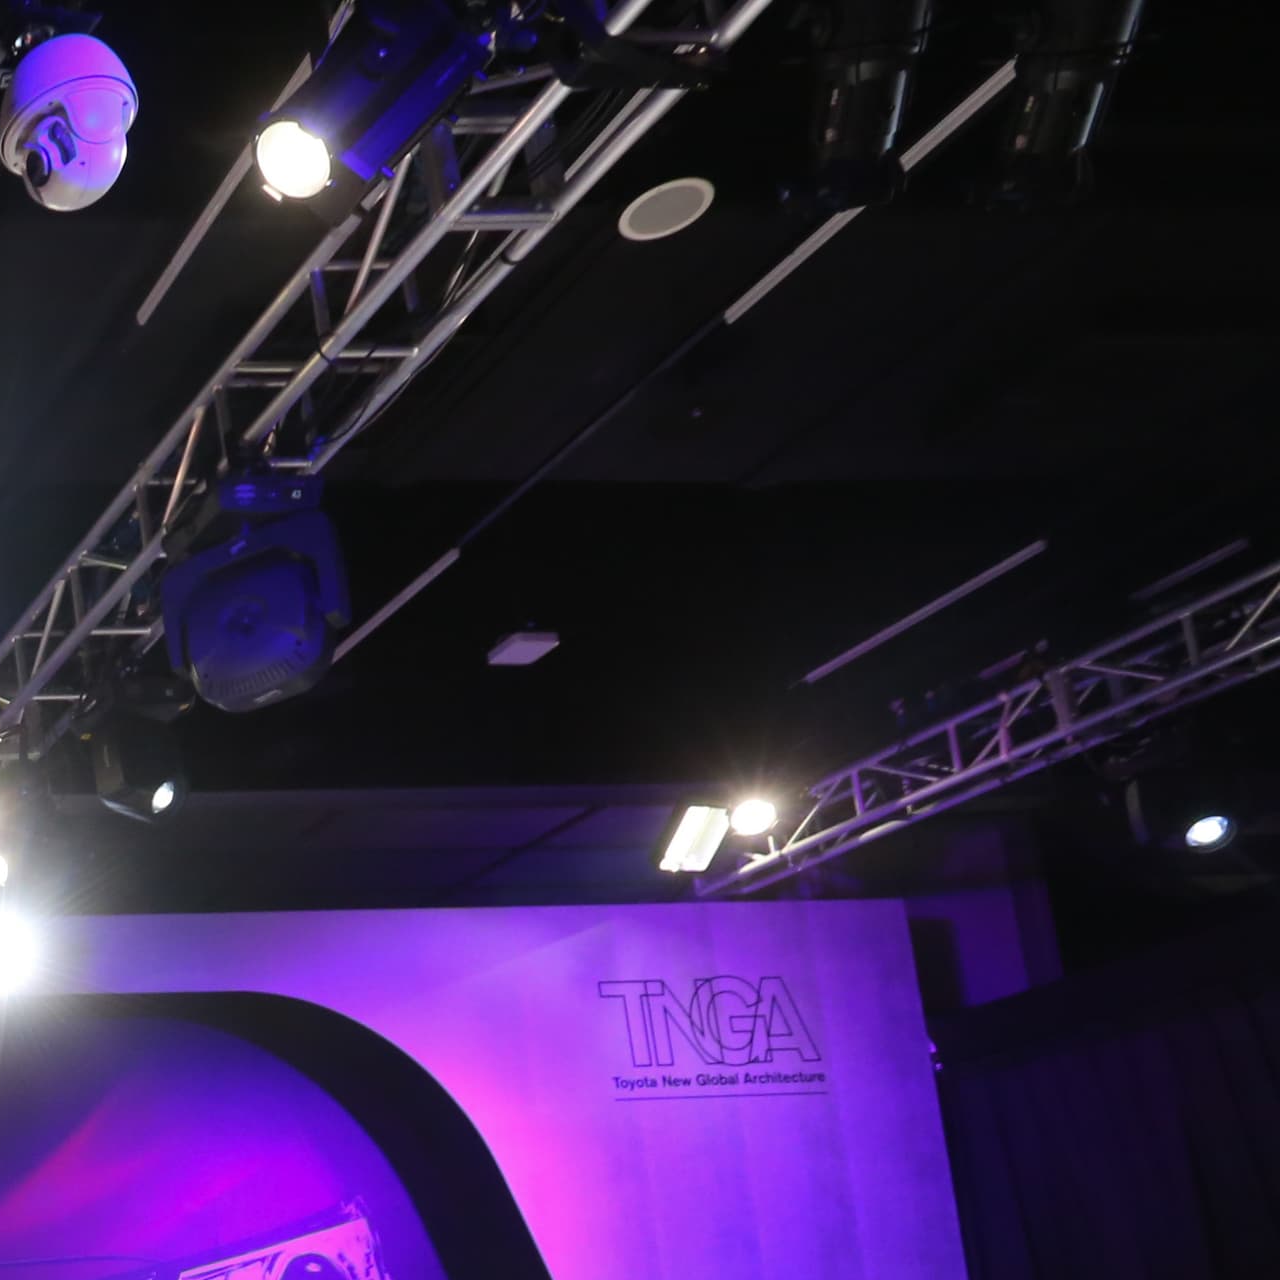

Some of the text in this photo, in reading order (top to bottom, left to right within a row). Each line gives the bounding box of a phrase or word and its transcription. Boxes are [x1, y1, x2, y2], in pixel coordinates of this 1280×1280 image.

[598, 975, 822, 1067] TNGA
[613, 1071, 825, 1091] Toyota New Global Architecture
